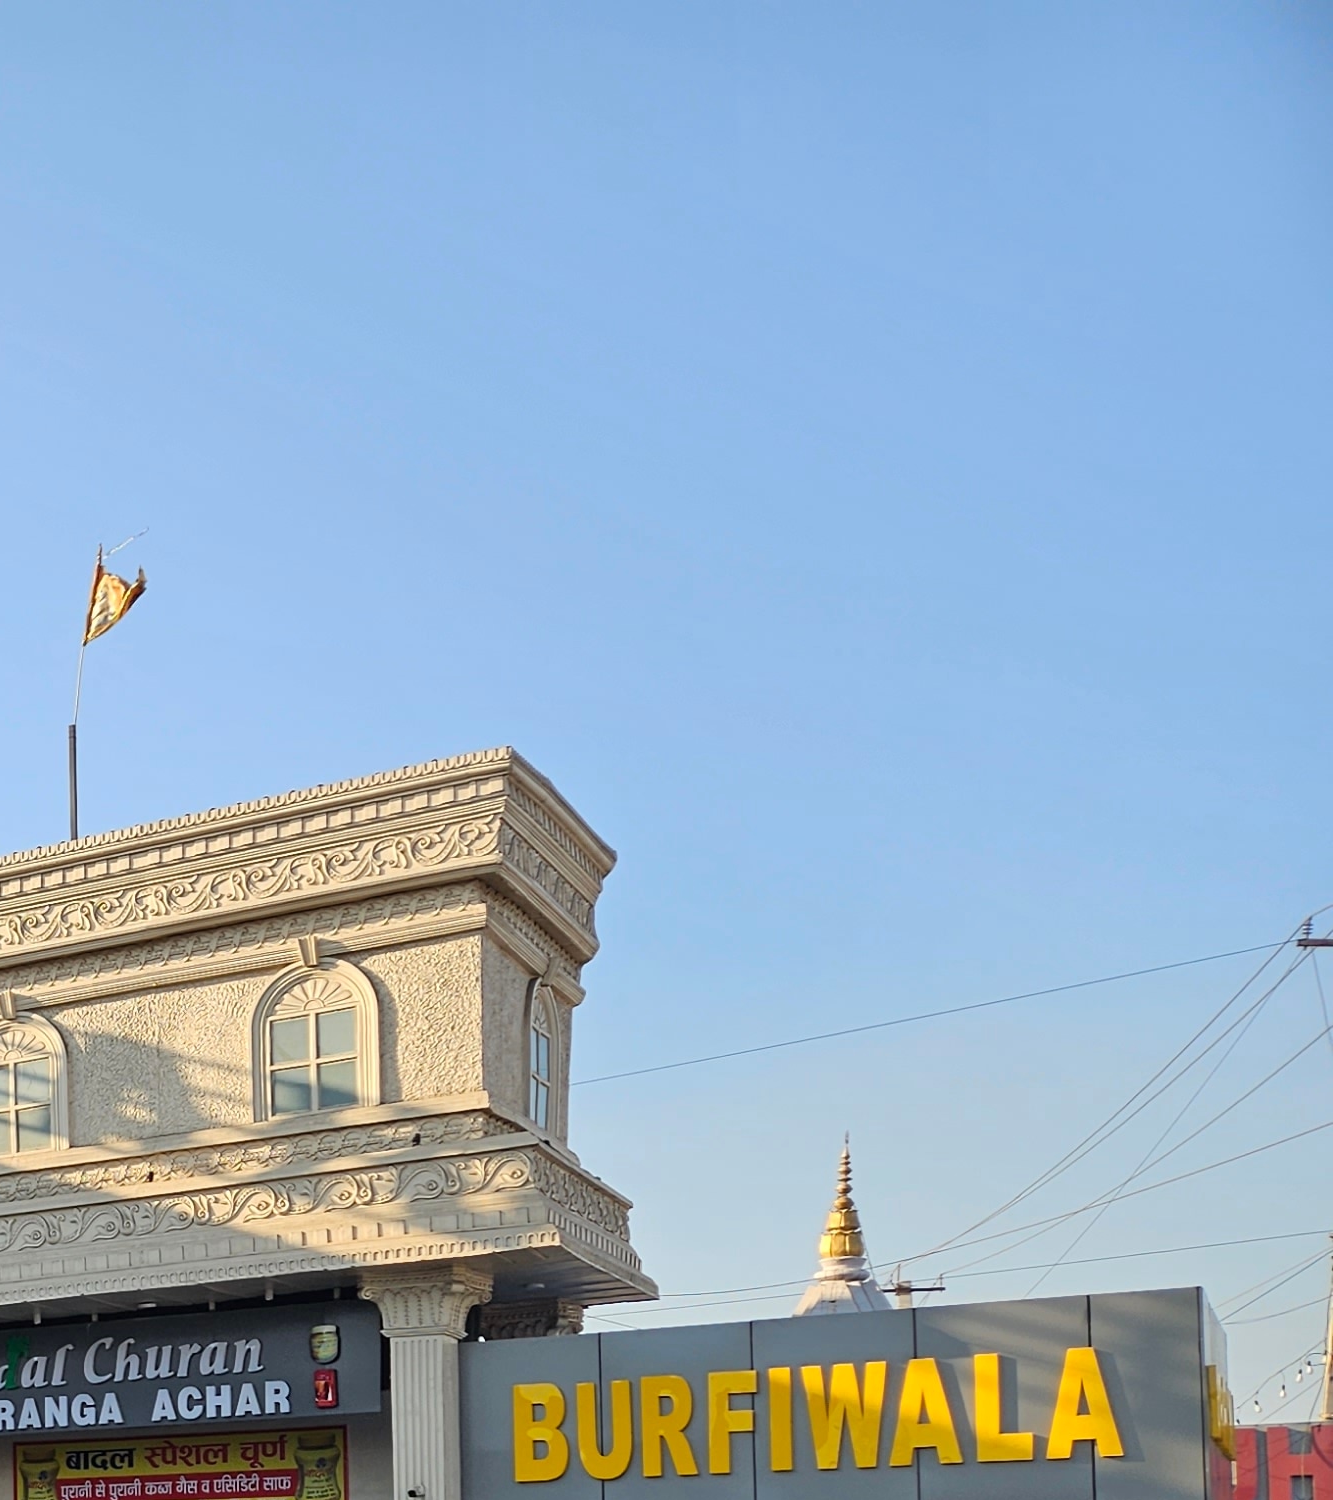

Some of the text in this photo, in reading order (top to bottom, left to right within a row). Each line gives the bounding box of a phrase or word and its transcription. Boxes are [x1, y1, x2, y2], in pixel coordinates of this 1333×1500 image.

[83, 1337, 264, 1385] Churan
[151, 1380, 291, 1422] ACHAR
[513, 1346, 1125, 1485] BURFIWALA
[65, 1434, 287, 1471] बादल स्पेशल चूर्ण
[94, 1481, 105, 1497] से
[109, 1478, 142, 1500] पुरानी
[175, 1475, 199, 1495] गैस
[201, 1479, 211, 1493] व
[213, 1473, 260, 1494] एसिडिटी
[263, 1475, 292, 1490] साफ
